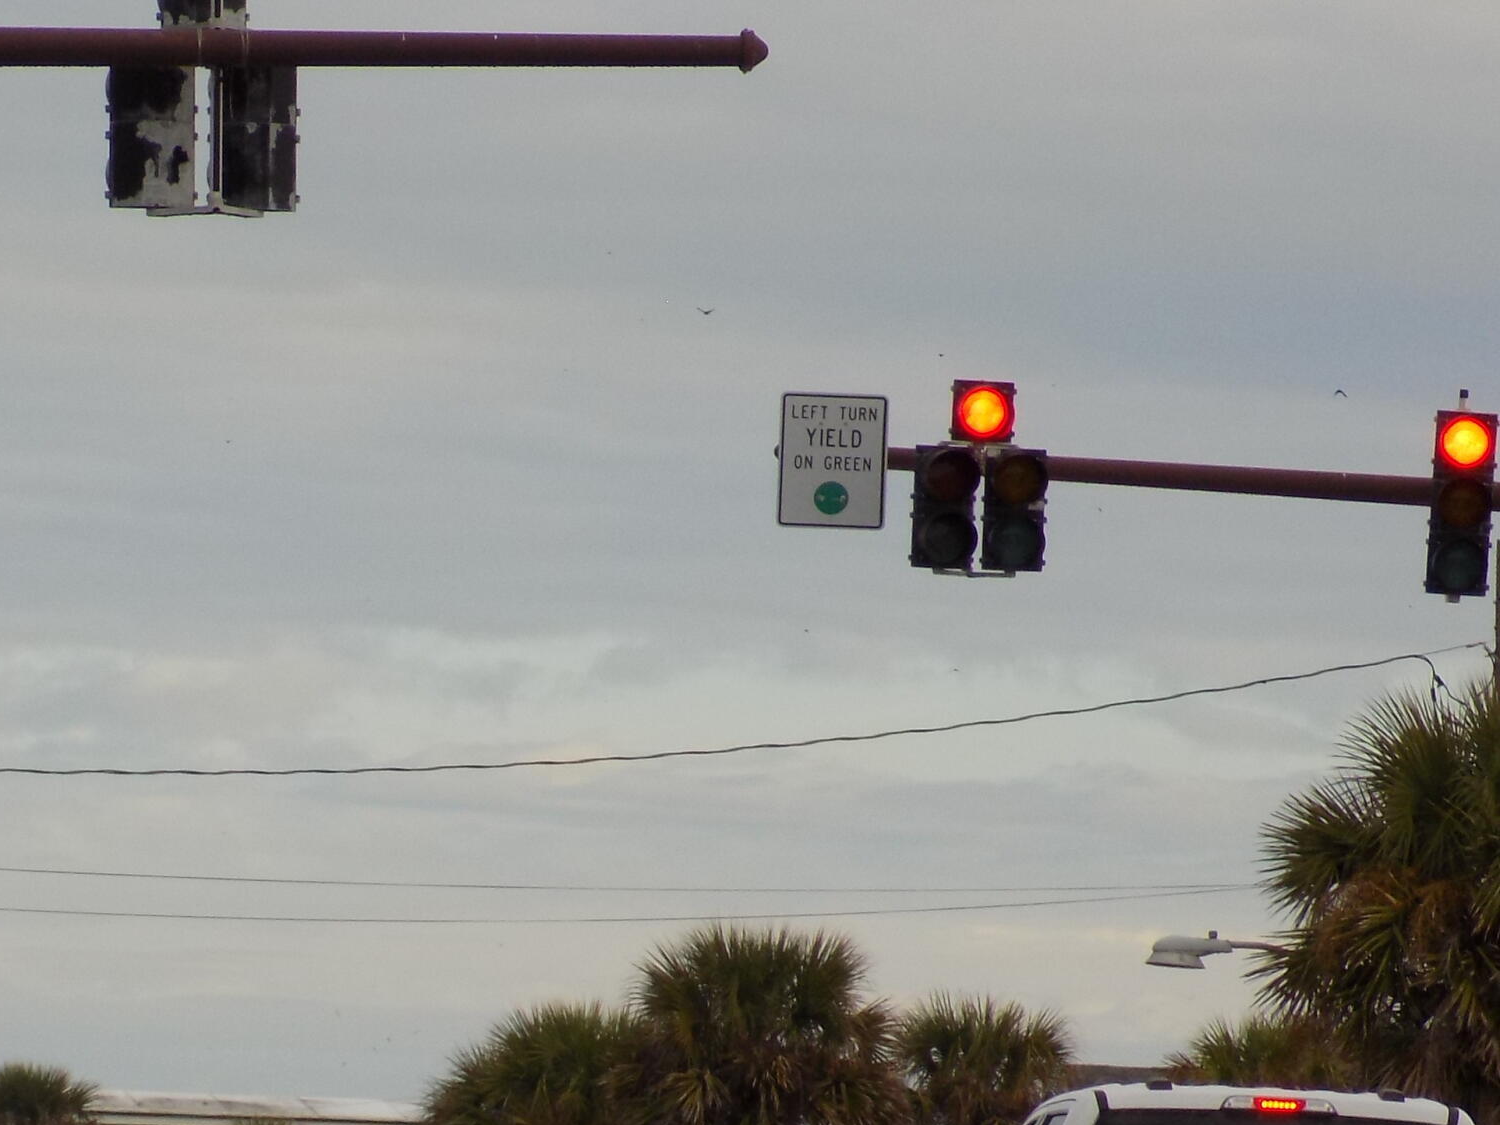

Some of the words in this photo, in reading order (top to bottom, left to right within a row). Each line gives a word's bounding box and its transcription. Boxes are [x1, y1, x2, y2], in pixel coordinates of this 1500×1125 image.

[792, 405, 828, 419] LEFT
[840, 407, 877, 421] TURN
[807, 428, 862, 448] YIELD
[794, 455, 813, 469] ON
[824, 456, 871, 471] GREEN
